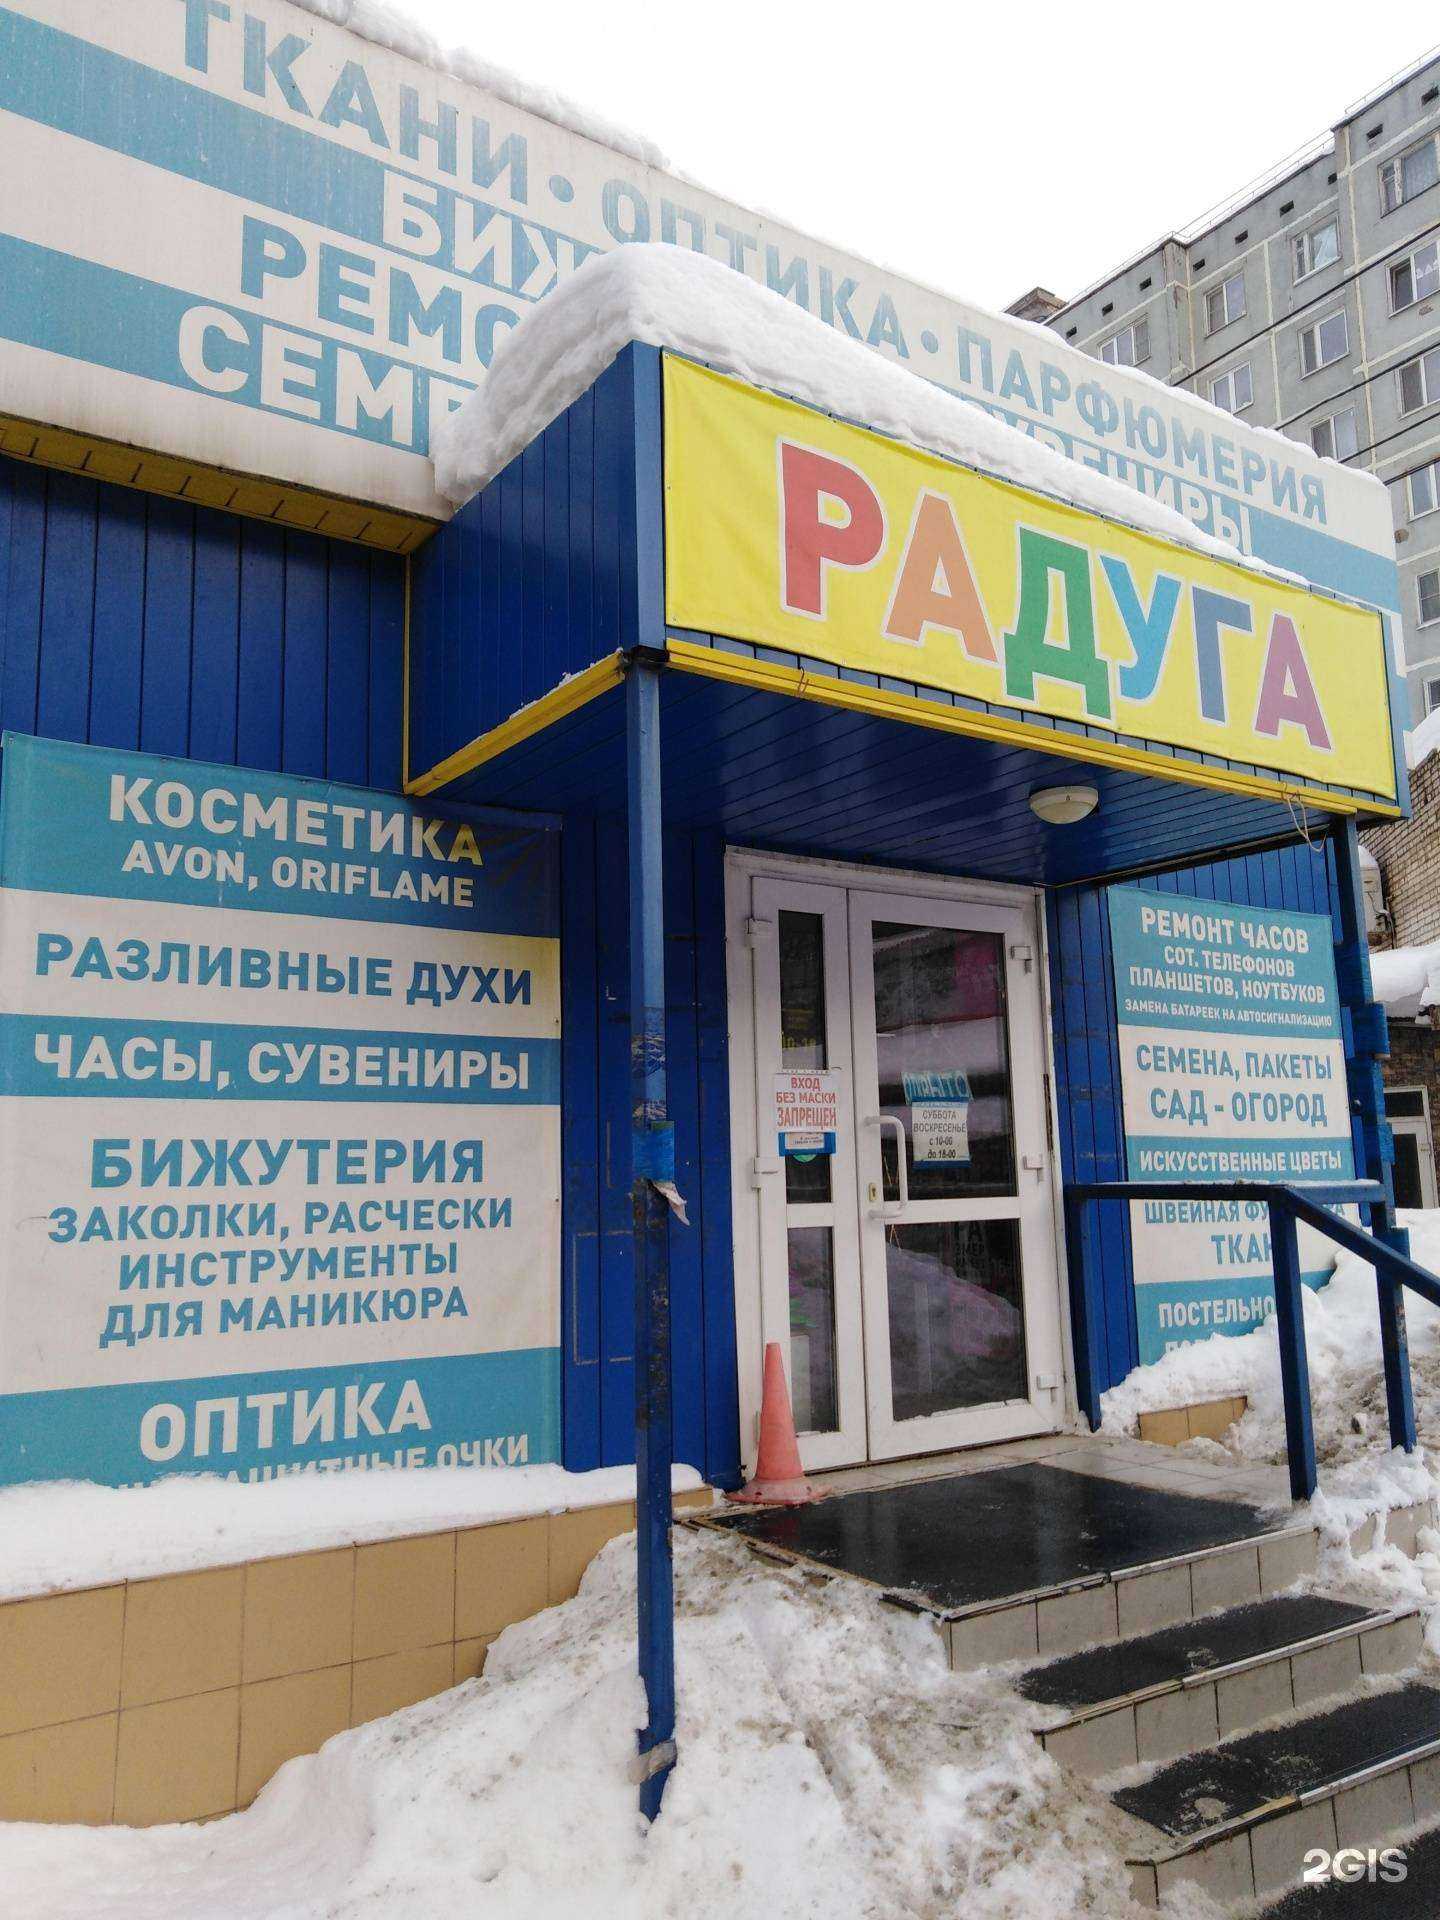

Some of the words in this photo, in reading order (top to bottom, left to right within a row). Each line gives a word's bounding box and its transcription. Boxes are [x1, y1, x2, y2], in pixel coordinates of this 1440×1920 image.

[183, 0, 528, 205] ТКАНИ
[602, 178, 910, 360] ОПТИКА
[957, 326, 1328, 525] ПАРФЮМЕРИЯ
[240, 214, 521, 370] РЕМО
[178, 305, 478, 447] СЕМ
[779, 439, 1334, 752] РАДУГА
[108, 774, 484, 867] КОСМЕТИКА
[121, 839, 259, 892] AVON,
[272, 856, 475, 908] ORIFLAME
[1140, 906, 1235, 945] РЕМОНТ
[1239, 923, 1310, 953] ЧАСОВ
[35, 933, 393, 996] РАЗЛИВНЫЕ
[406, 962, 532, 1007] ДУХИ
[1129, 966, 1239, 1000] ПЛАНШЕТОВ,
[1243, 979, 1326, 1004] НОУТБУКОВ
[1164, 946, 1199, 967] СОТ.
[1202, 950, 1295, 978] ТЕЛЕФОНОВ
[1125, 998, 1169, 1014] ЗАМЕНА
[1171, 1002, 1220, 1020] БАТАРЕЕК
[1222, 1009, 1236, 1021] НА
[1237, 1009, 1332, 1027] АВТОСИГНАЛИЗАЦИЮ
[34, 1033, 231, 1091] ЧАСЫ,
[248, 1042, 530, 1090] СУВЕНИРЫ
[790, 1076, 821, 1091] ВХОД
[1136, 1044, 1240, 1082] СЕМЕНА,
[1246, 1051, 1332, 1080] ПАКЕТЫ
[776, 1091, 796, 1104] БЕЗ
[799, 1091, 836, 1104] МАСКИ
[776, 1106, 837, 1130] ЗАПРЕЩЕН
[922, 1110, 957, 1120] СУББОТА
[1150, 1087, 1208, 1126] САД
[1231, 1092, 1328, 1127] ОГОРОД
[913, 1122, 966, 1133] ВОСКРЕСЕНЬЕ
[90, 1138, 484, 1188] БИЖУТЕРИЯ
[1140, 1150, 1287, 1173] ИСКУССТВЕННЫЕ
[1290, 1150, 1342, 1174] ЦВЕТЫ
[48, 1202, 289, 1243] ЗАКОЛКИ,
[304, 1197, 513, 1235] РАСЧЕСКИ
[119, 1242, 458, 1290] ИНСТРУМЕНТЫ
[99, 1301, 203, 1349] ДЛЯ
[219, 1286, 469, 1333] МАНИКЮРА
[1158, 1295, 1277, 1328] ПОСТЕЛЬНО
[140, 1379, 432, 1462] ОПТИКА
[436, 1434, 530, 1470] ОЧКИ
